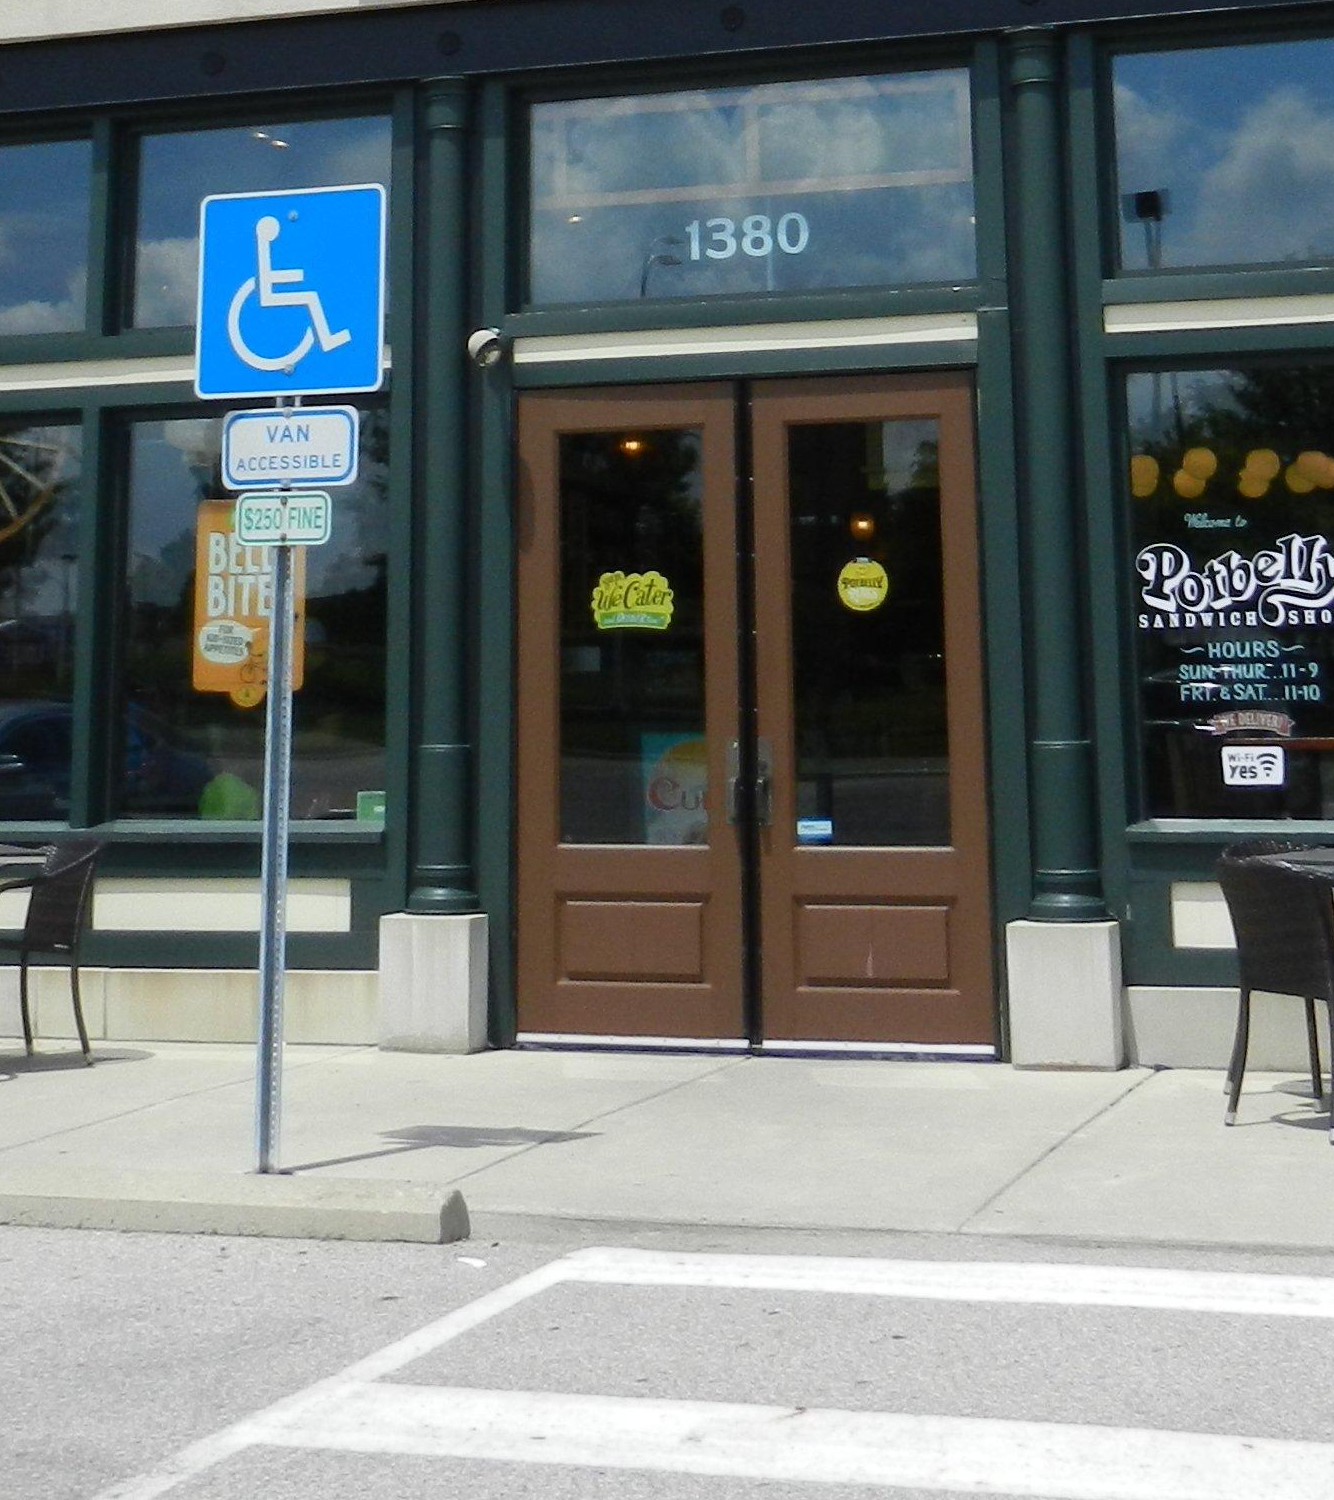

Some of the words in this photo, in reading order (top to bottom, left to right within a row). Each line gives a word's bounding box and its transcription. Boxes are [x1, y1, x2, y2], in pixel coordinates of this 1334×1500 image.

[684, 212, 810, 261] 1380
[267, 424, 310, 443] VAN
[235, 453, 343, 472] ACCESSIBLE
[243, 507, 283, 531] $250
[287, 506, 324, 530] FINE
[1183, 512, 1231, 529] Welcome
[1234, 514, 1248, 528] to
[623, 578, 671, 609] Cater
[1138, 611, 1258, 629] SANDWICH
[1207, 640, 1281, 658] HOURS
[1227, 753, 1255, 762] Wi-Fi
